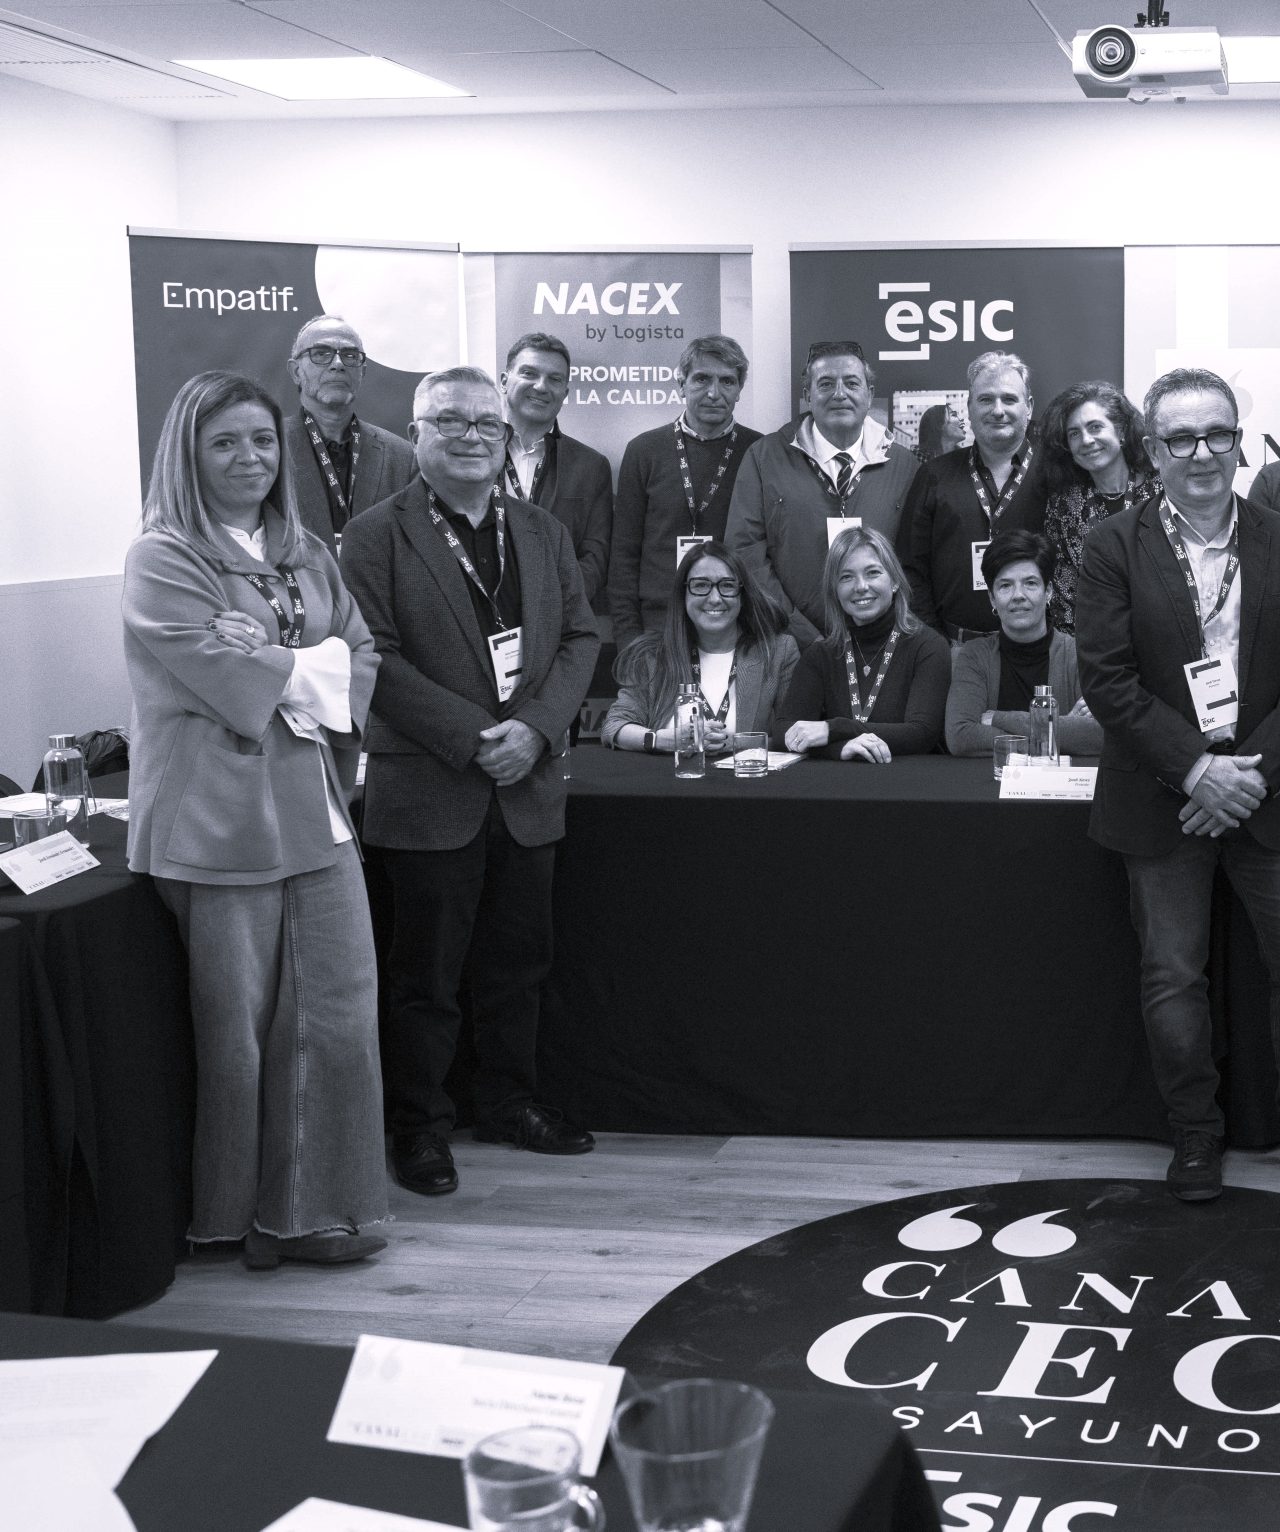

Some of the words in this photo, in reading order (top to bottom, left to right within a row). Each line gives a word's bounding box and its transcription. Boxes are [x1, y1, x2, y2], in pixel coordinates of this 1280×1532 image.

[163, 282, 298, 316] Empatif.
[533, 282, 683, 315] NACEX
[586, 324, 606, 342] by
[613, 325, 684, 342] logista
[576, 389, 600, 405] LA
[607, 389, 687, 405] CALIDA
[1164, 518, 1177, 534] esic
[1174, 544, 1188, 560] esic
[1228, 554, 1238, 572] esic
[1186, 570, 1196, 588] esic
[1221, 582, 1230, 599] esic
[1202, 718, 1216, 726] esic
